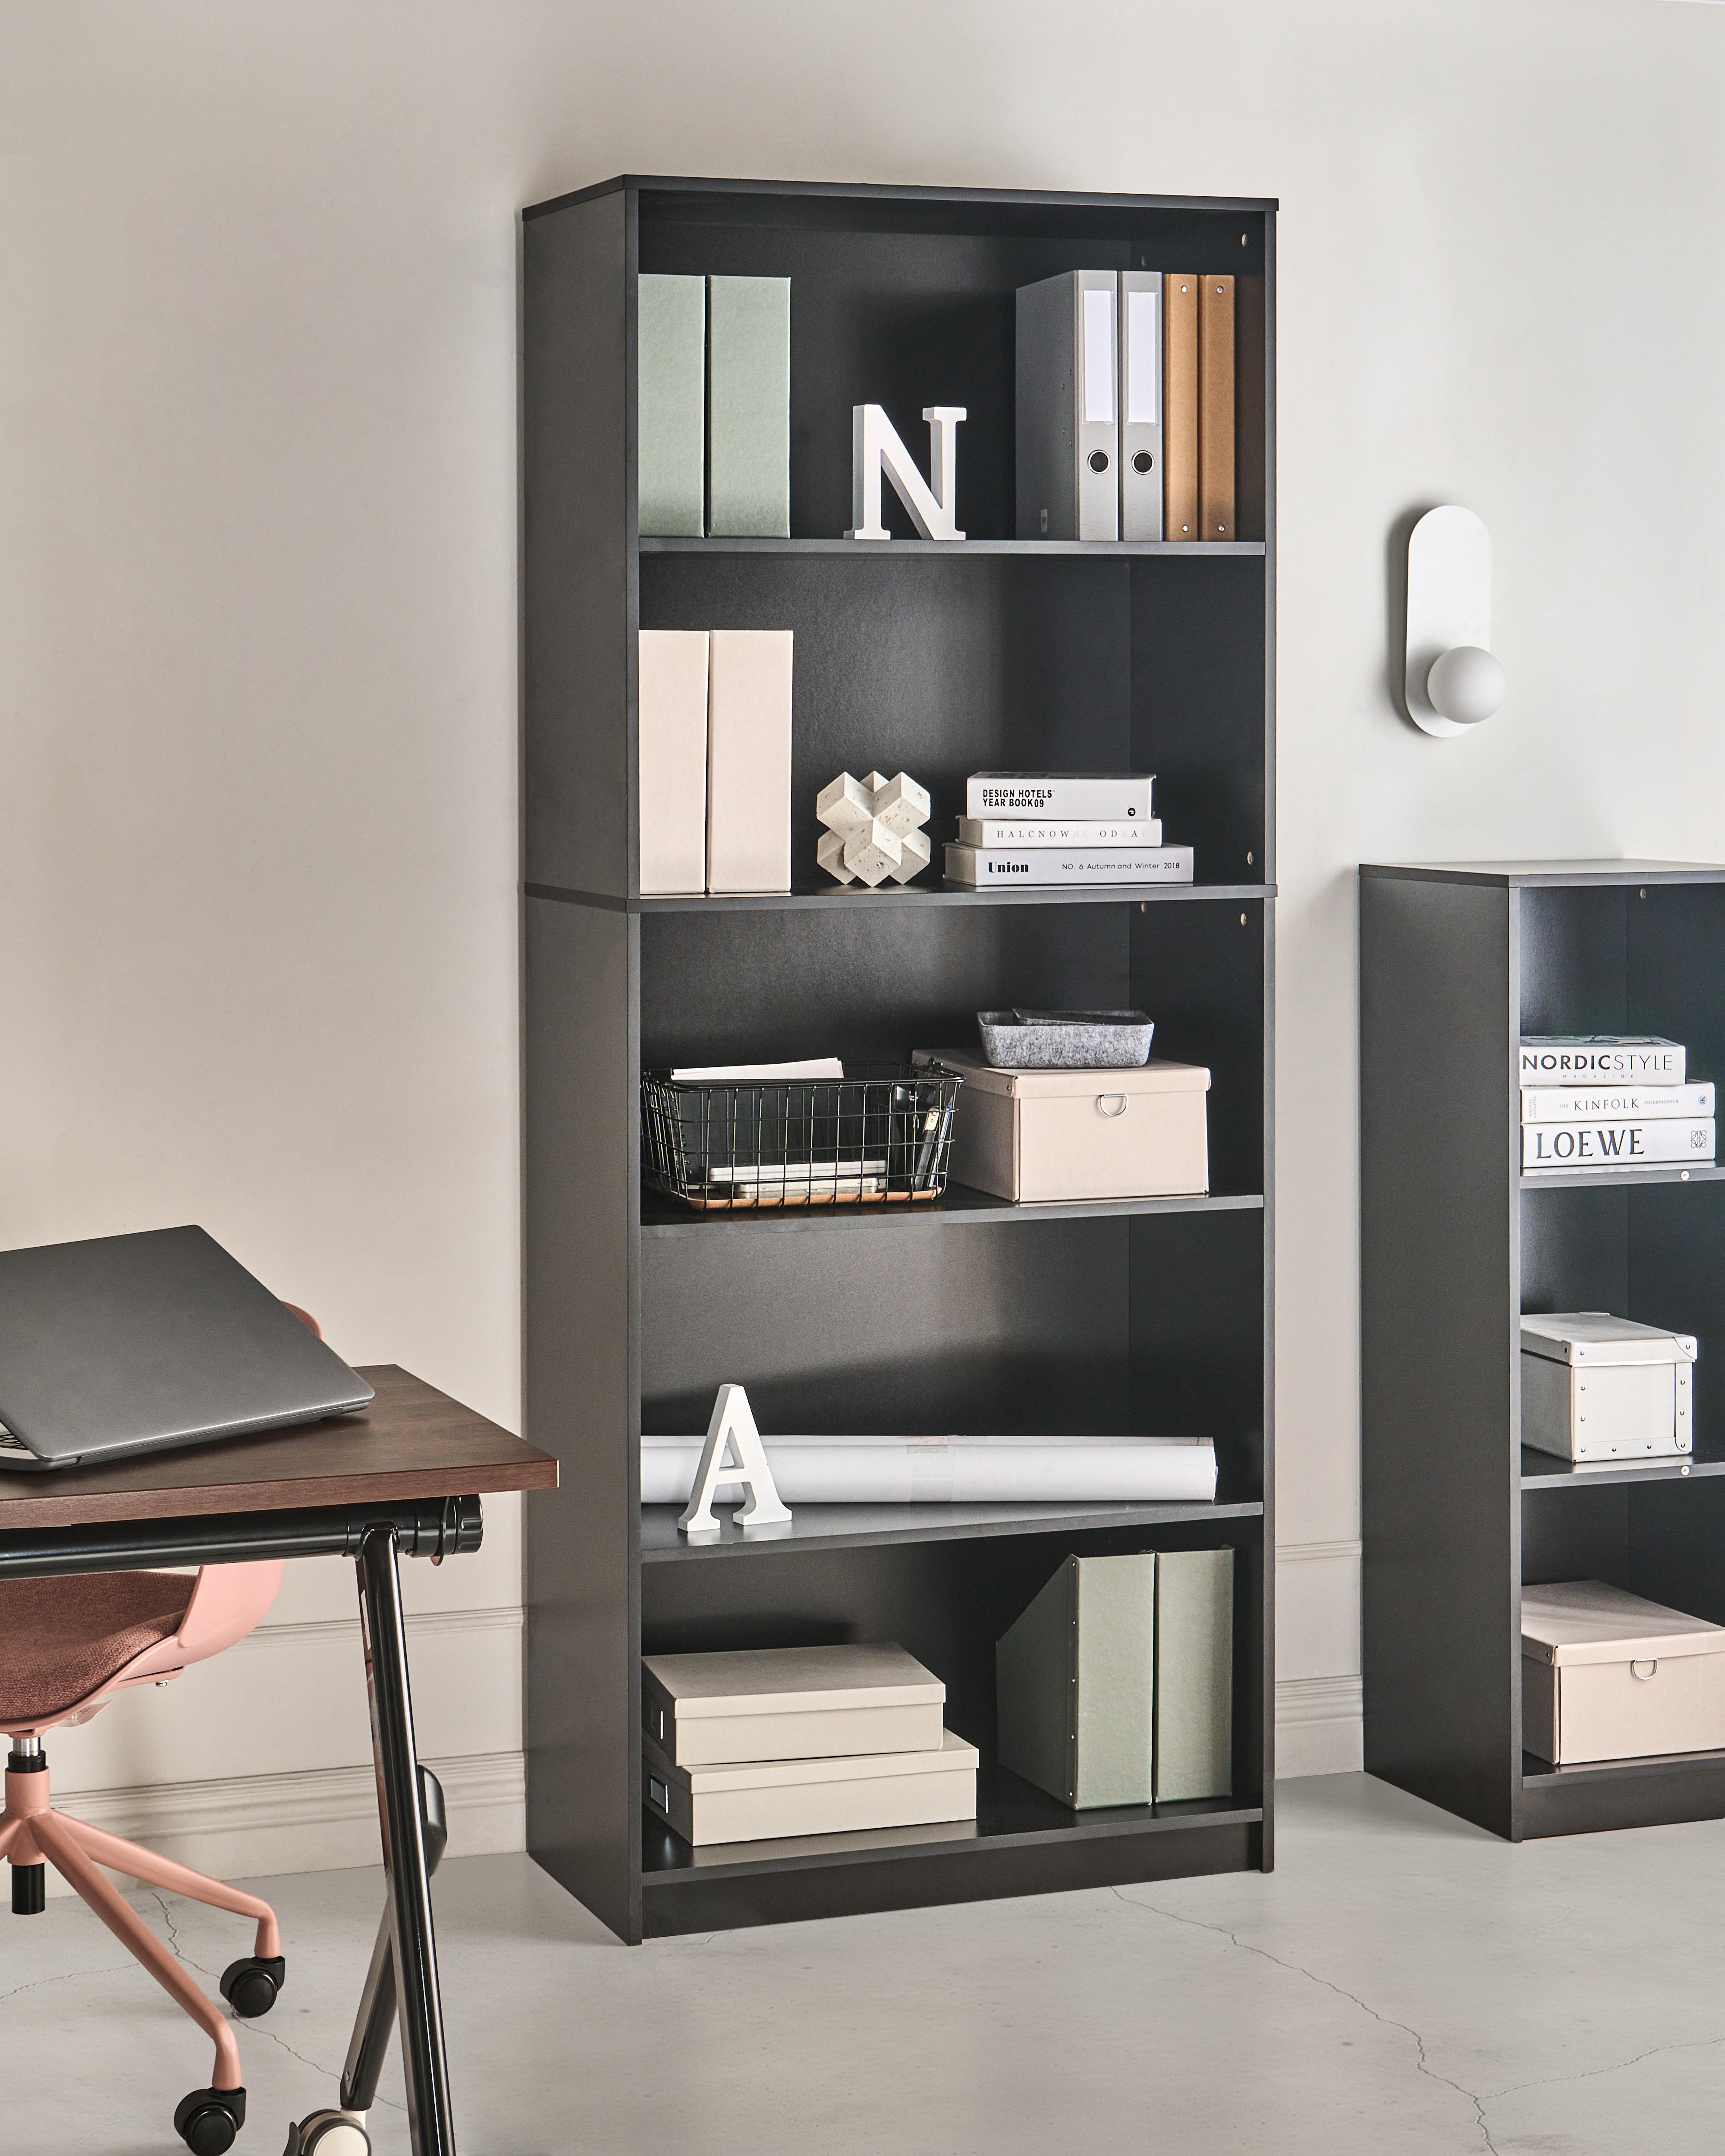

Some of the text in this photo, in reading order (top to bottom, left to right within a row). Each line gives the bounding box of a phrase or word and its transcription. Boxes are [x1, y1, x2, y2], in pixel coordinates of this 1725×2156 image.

[843, 403, 967, 541] N
[982, 789, 1015, 798] DESIGN
[983, 798, 1005, 807] YEAR
[988, 861, 1029, 873] Union
[1574, 1098, 1640, 1111] KINFOLK
[1536, 1128, 1645, 1160] LOEWE
[678, 1383, 792, 1532] A
